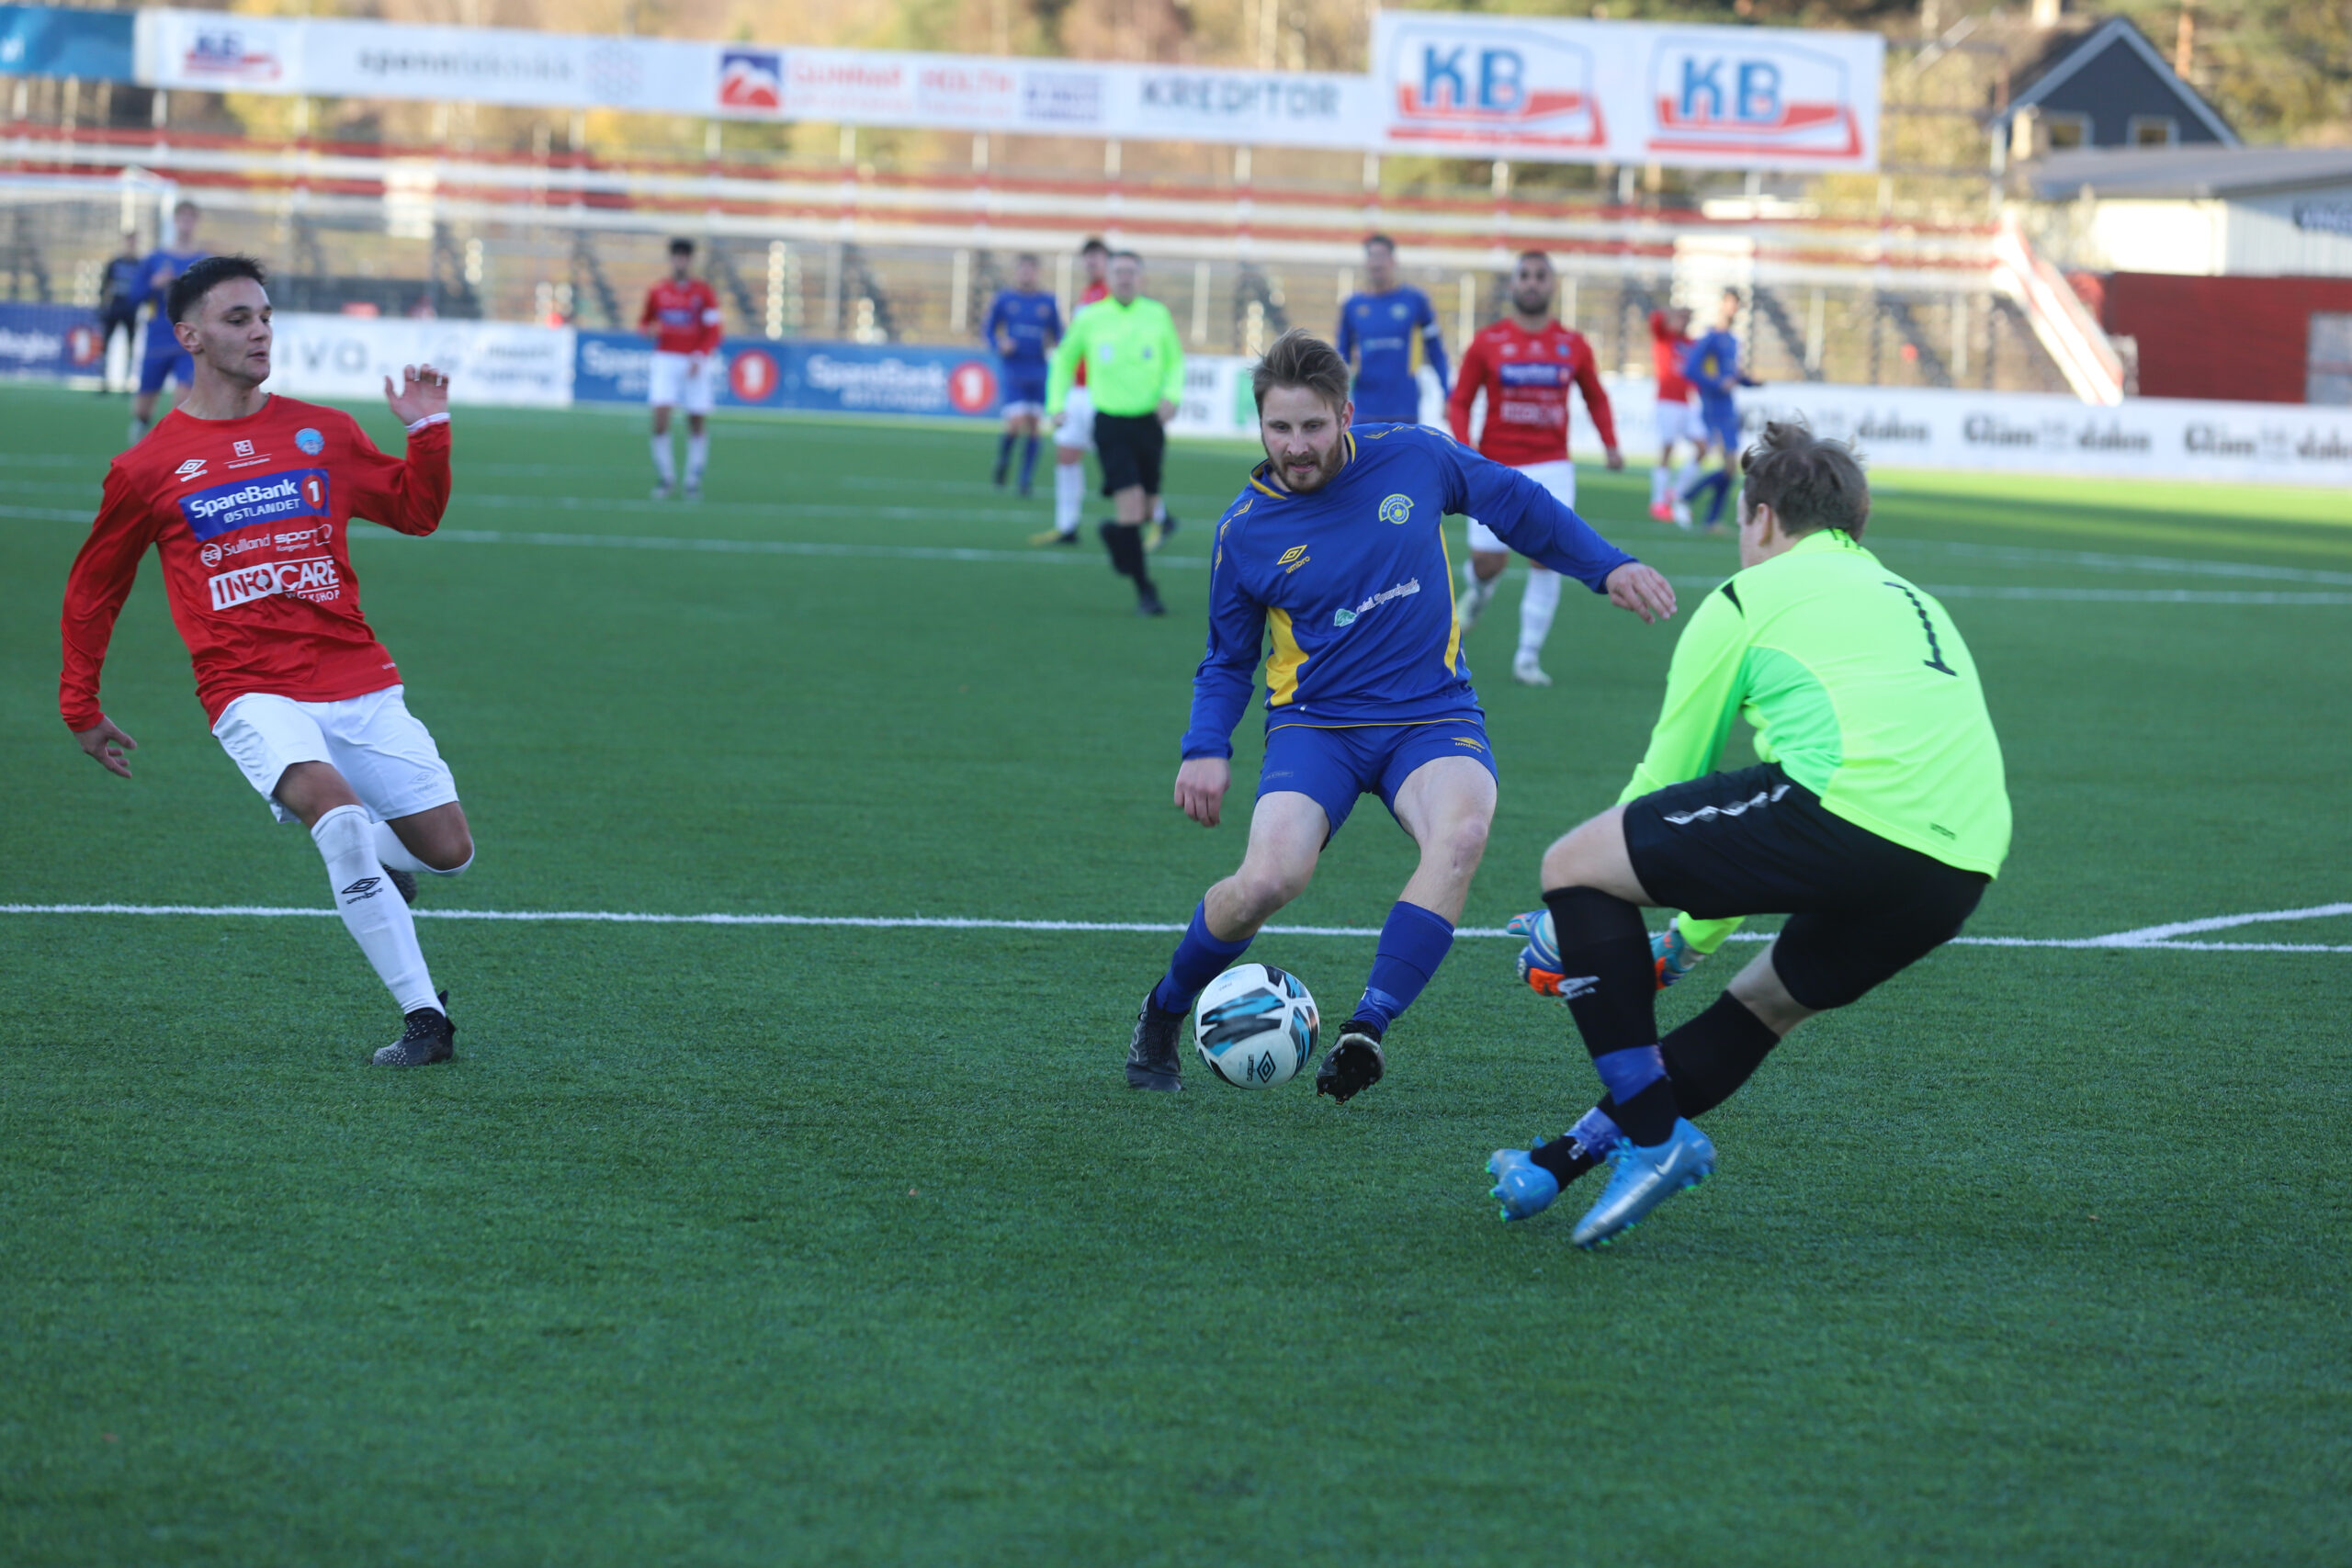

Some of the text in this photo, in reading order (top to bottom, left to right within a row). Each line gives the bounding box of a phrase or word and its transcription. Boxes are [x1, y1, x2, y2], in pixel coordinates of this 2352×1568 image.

[1140, 76, 1340, 117] KREDITOR
[1422, 44, 1524, 109] KB
[1681, 56, 1781, 121] KB
[959, 368, 983, 408] 1
[189, 479, 321, 519] SpareBank 1
[223, 498, 300, 524] ØSTLANDET
[222, 533, 271, 557] Sulland
[1285, 556, 1310, 573] umbro
[214, 558, 340, 605] INFOCARE
[1883, 581, 1959, 677] 1
[1454, 741, 1482, 753] umbro
[345, 887, 383, 905] umbro
